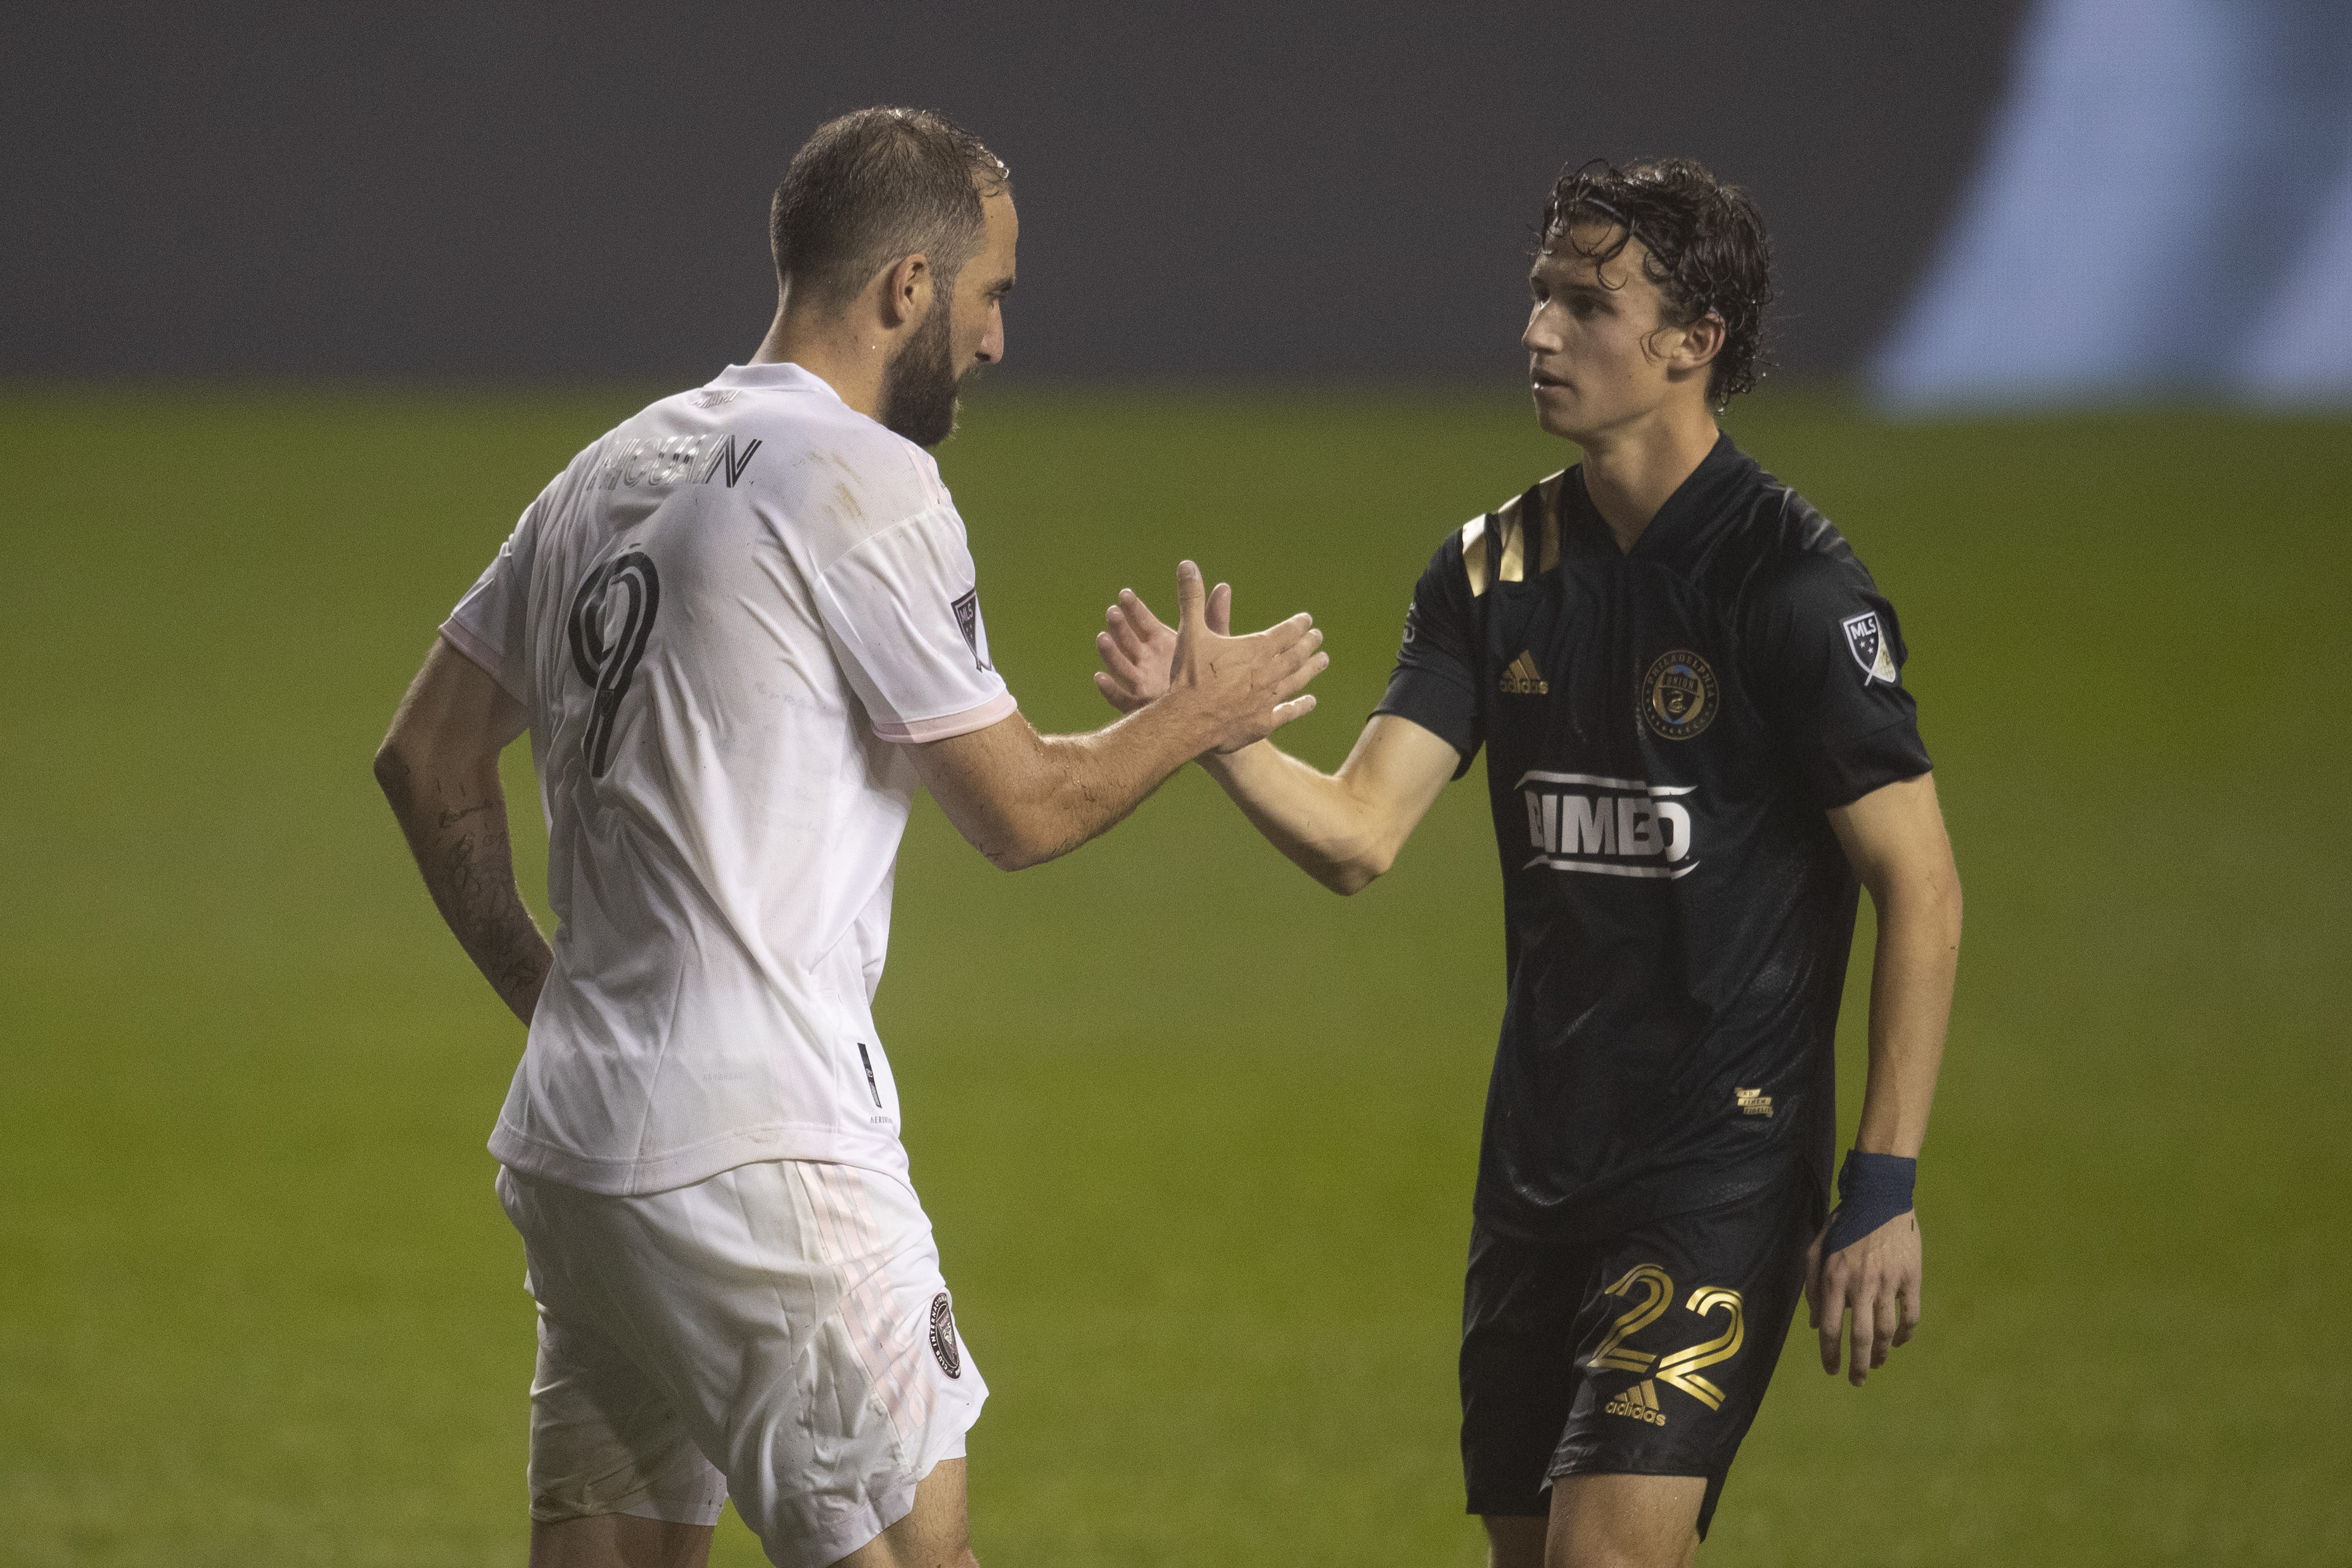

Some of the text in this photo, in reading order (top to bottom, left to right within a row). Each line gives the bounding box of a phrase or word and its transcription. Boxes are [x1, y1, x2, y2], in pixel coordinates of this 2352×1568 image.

[959, 603, 973, 623] MLS
[1850, 618, 1877, 640] MLS
[568, 551, 660, 779] 9
[1647, 653, 1715, 698] PHILADELPHIA
[1500, 678, 1549, 694] adidas
[1666, 675, 1694, 690] UNION
[931, 1296, 947, 1347] INTERNACIONA
[1587, 1263, 1744, 1412] 22
[936, 1351, 948, 1370] CLUB
[1605, 1401, 1666, 1427] adidas
